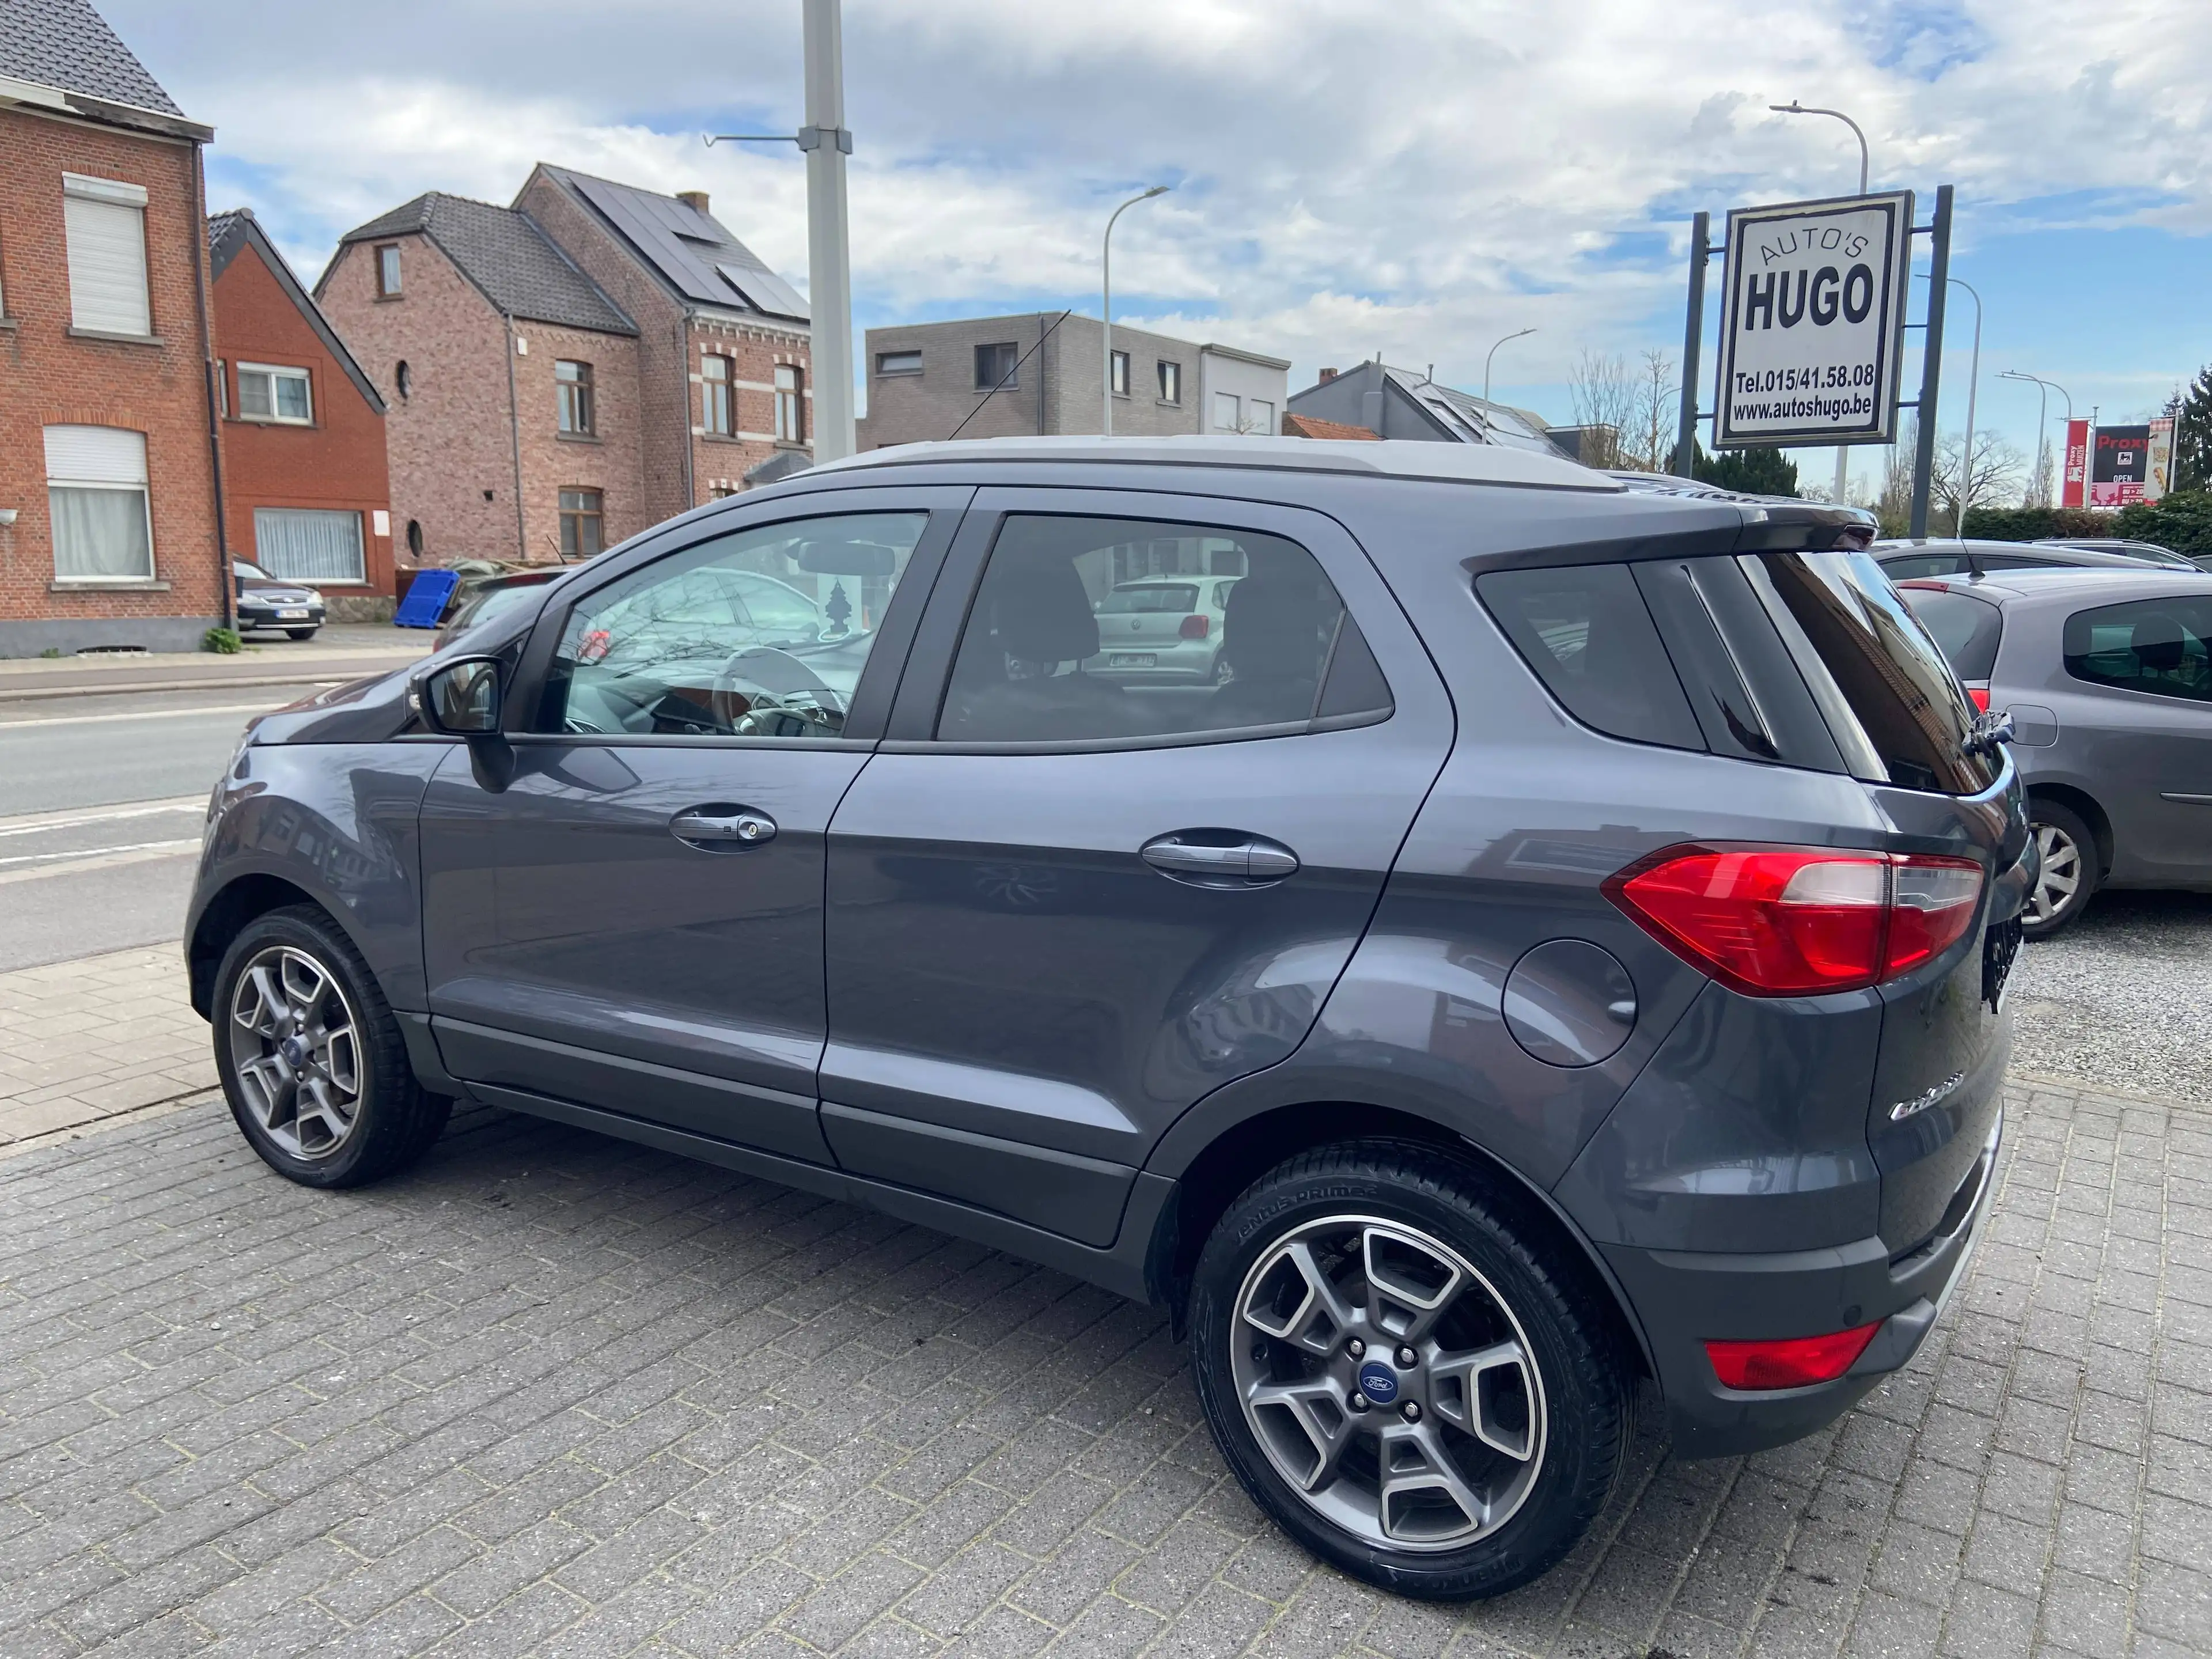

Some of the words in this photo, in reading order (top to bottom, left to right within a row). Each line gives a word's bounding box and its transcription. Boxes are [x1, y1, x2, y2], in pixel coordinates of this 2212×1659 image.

[1760, 227, 1869, 266] AUTO'S
[1745, 263, 1874, 331] HUGO
[1735, 363, 1874, 394] Tel.015/41.58.08
[1733, 393, 1872, 421] www.autoshugo.be
[2067, 445, 2078, 466] Proxy
[2098, 435, 2149, 453] Proxy
[2113, 475, 2133, 483] OPEN
[1368, 1378, 1388, 1389] Ford
